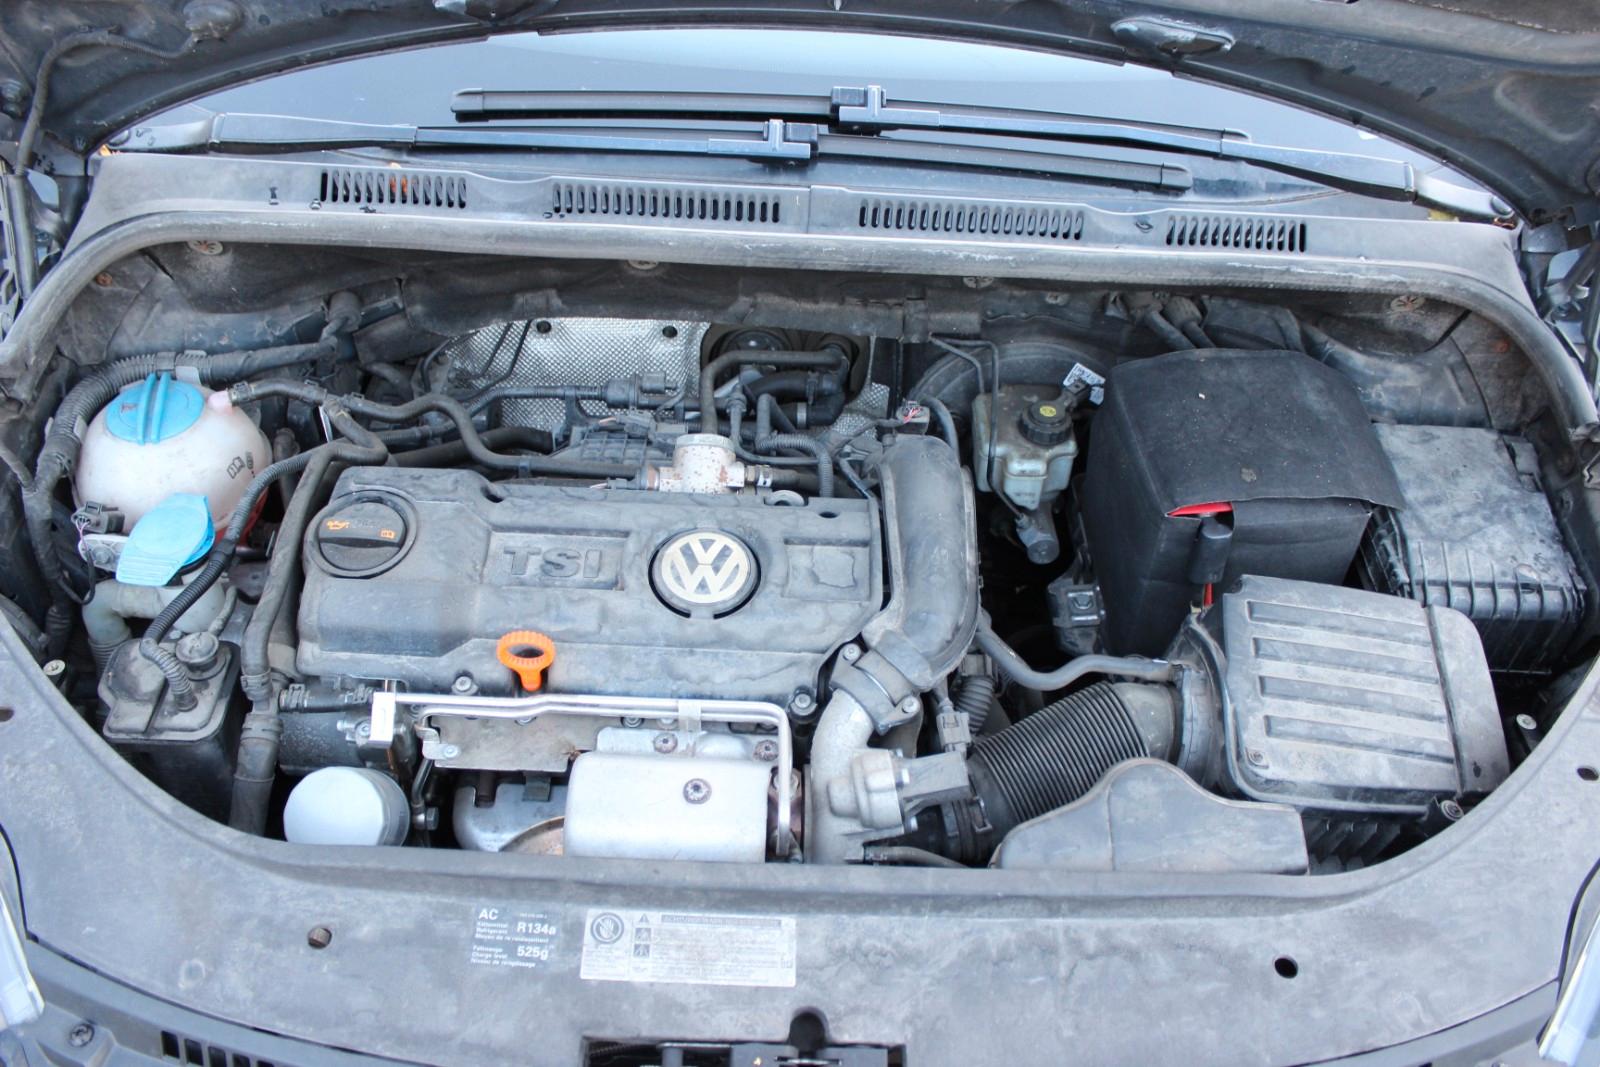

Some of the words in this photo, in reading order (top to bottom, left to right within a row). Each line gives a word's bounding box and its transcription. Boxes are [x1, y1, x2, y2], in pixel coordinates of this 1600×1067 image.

[504, 547, 602, 578] TSI
[660, 532, 750, 603] VW
[479, 908, 498, 920] AC
[517, 921, 556, 935] R134a
[517, 945, 549, 960] 525g
